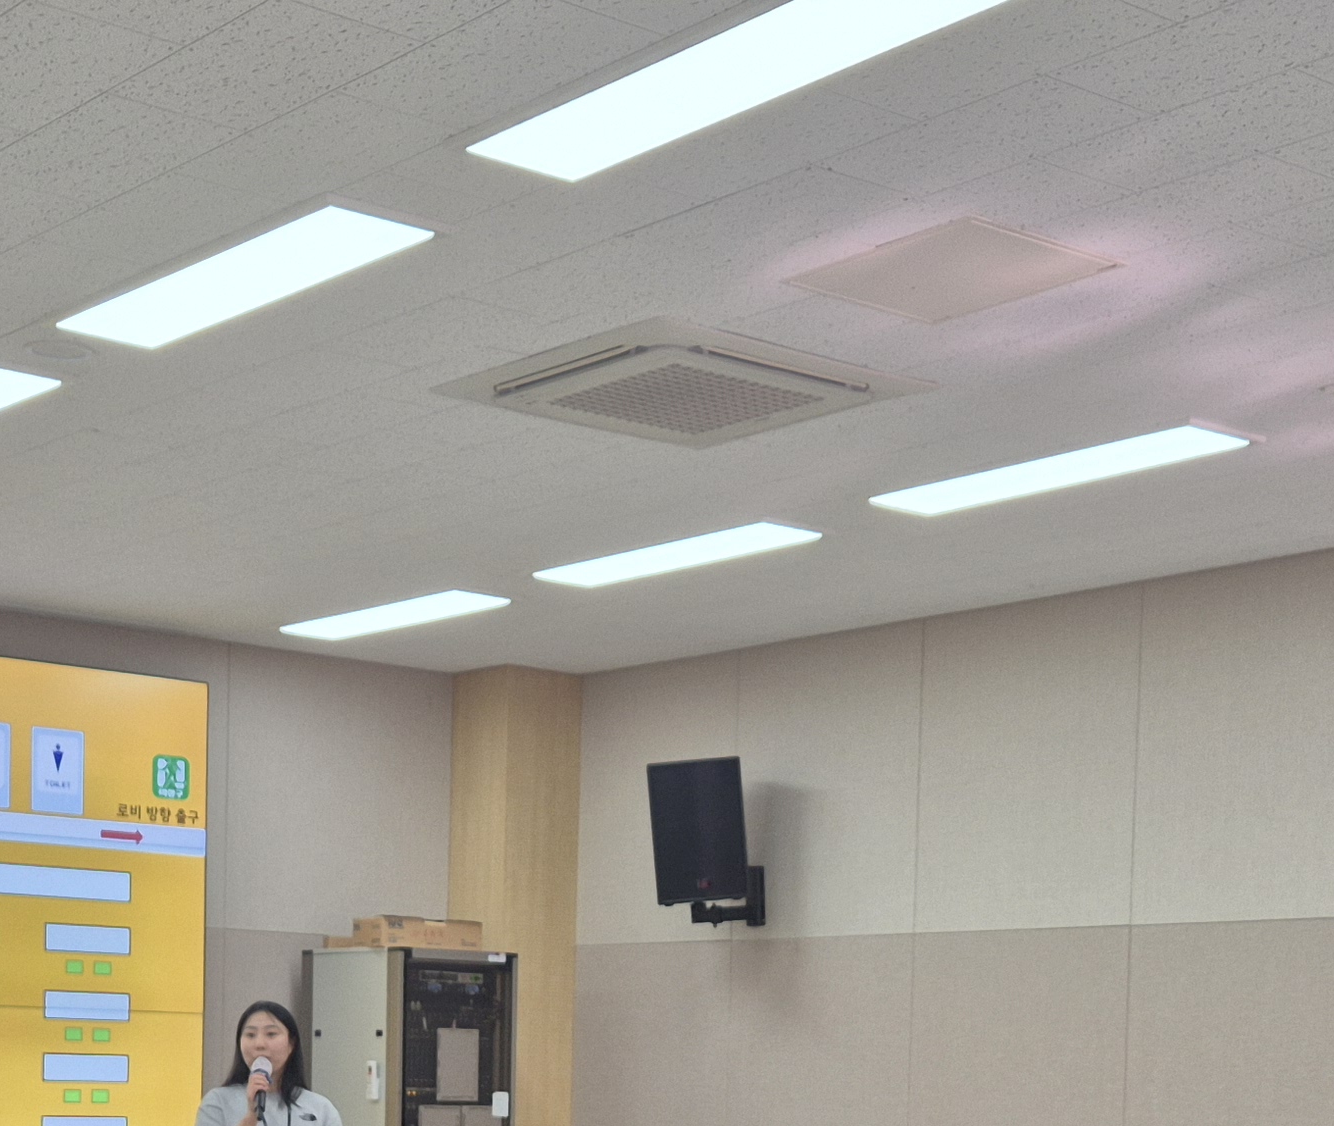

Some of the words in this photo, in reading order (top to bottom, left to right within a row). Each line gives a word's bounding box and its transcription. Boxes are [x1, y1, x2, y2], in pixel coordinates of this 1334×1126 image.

[117, 803, 141, 820] 로비
[146, 806, 171, 822] 방향
[175, 808, 199, 825] 출구
